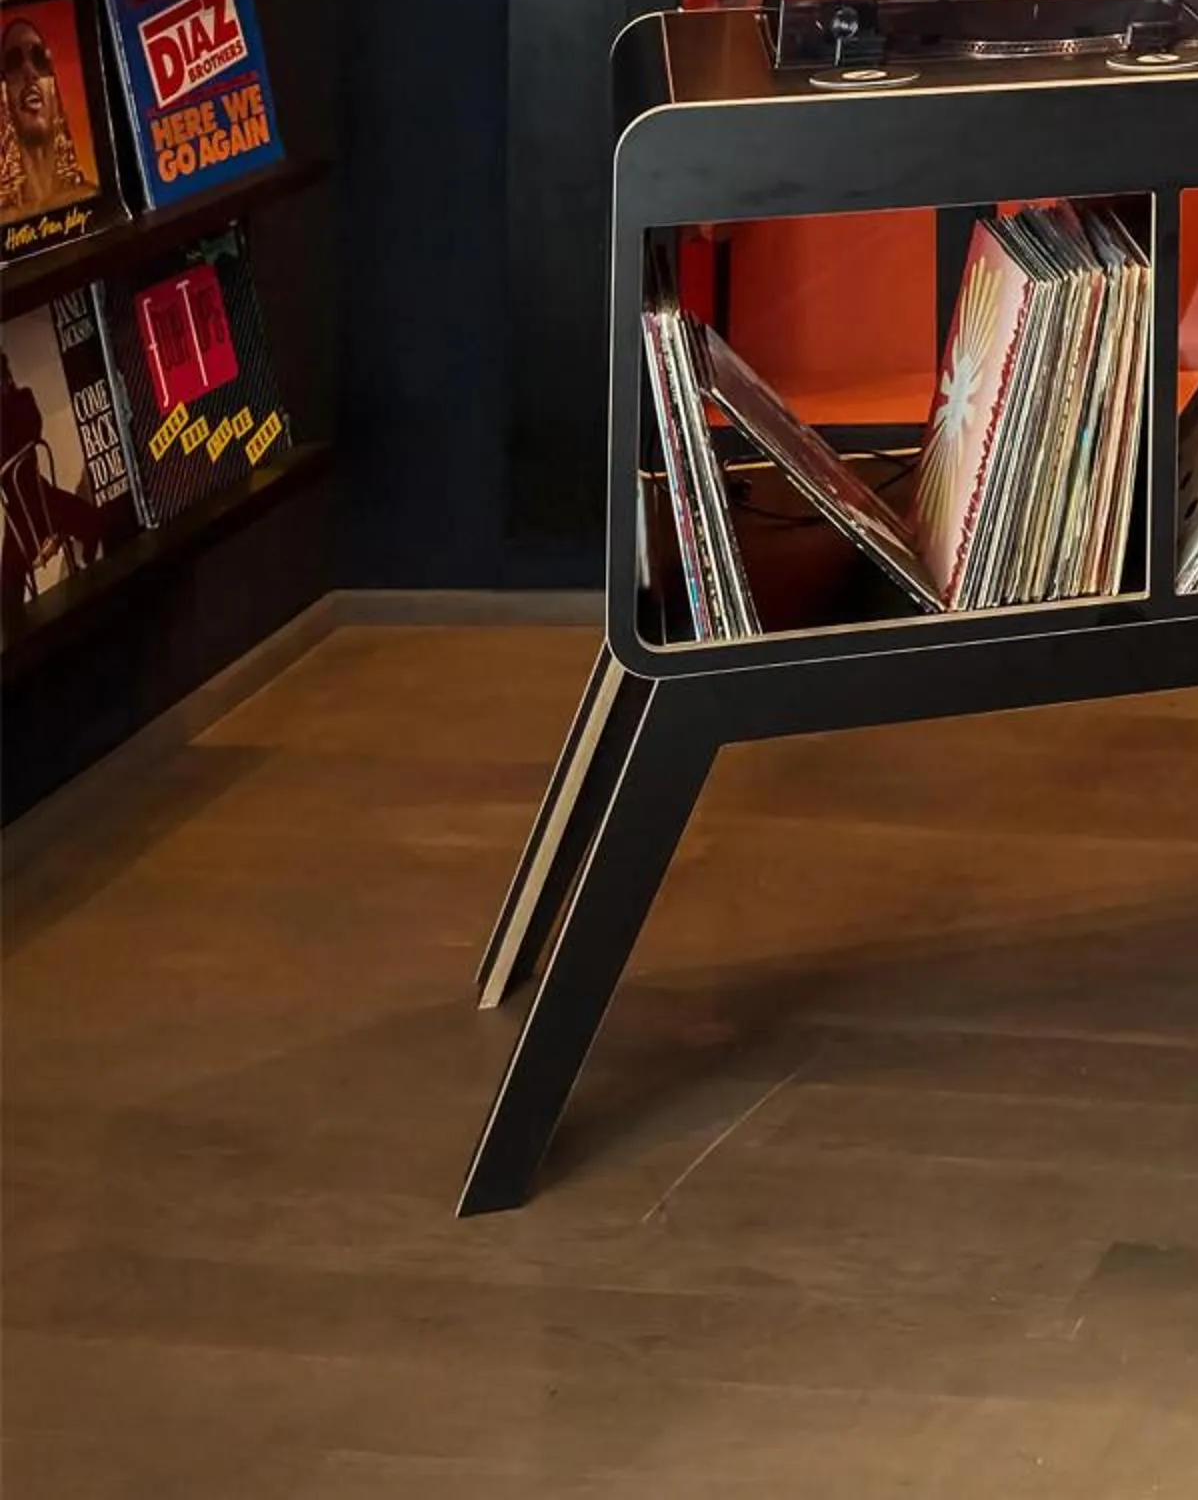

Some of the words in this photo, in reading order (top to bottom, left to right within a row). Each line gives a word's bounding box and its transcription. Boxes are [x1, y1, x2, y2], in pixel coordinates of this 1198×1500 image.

[187, 40, 243, 84] BROTHERS
[151, 103, 217, 149] HERE
[221, 84, 265, 128] WE
[158, 144, 196, 183] GO
[198, 116, 271, 167] AGAIN
[73, 377, 112, 423] COME
[80, 409, 121, 459] BACK
[88, 453, 108, 491] TO
[106, 445, 127, 482] ME
